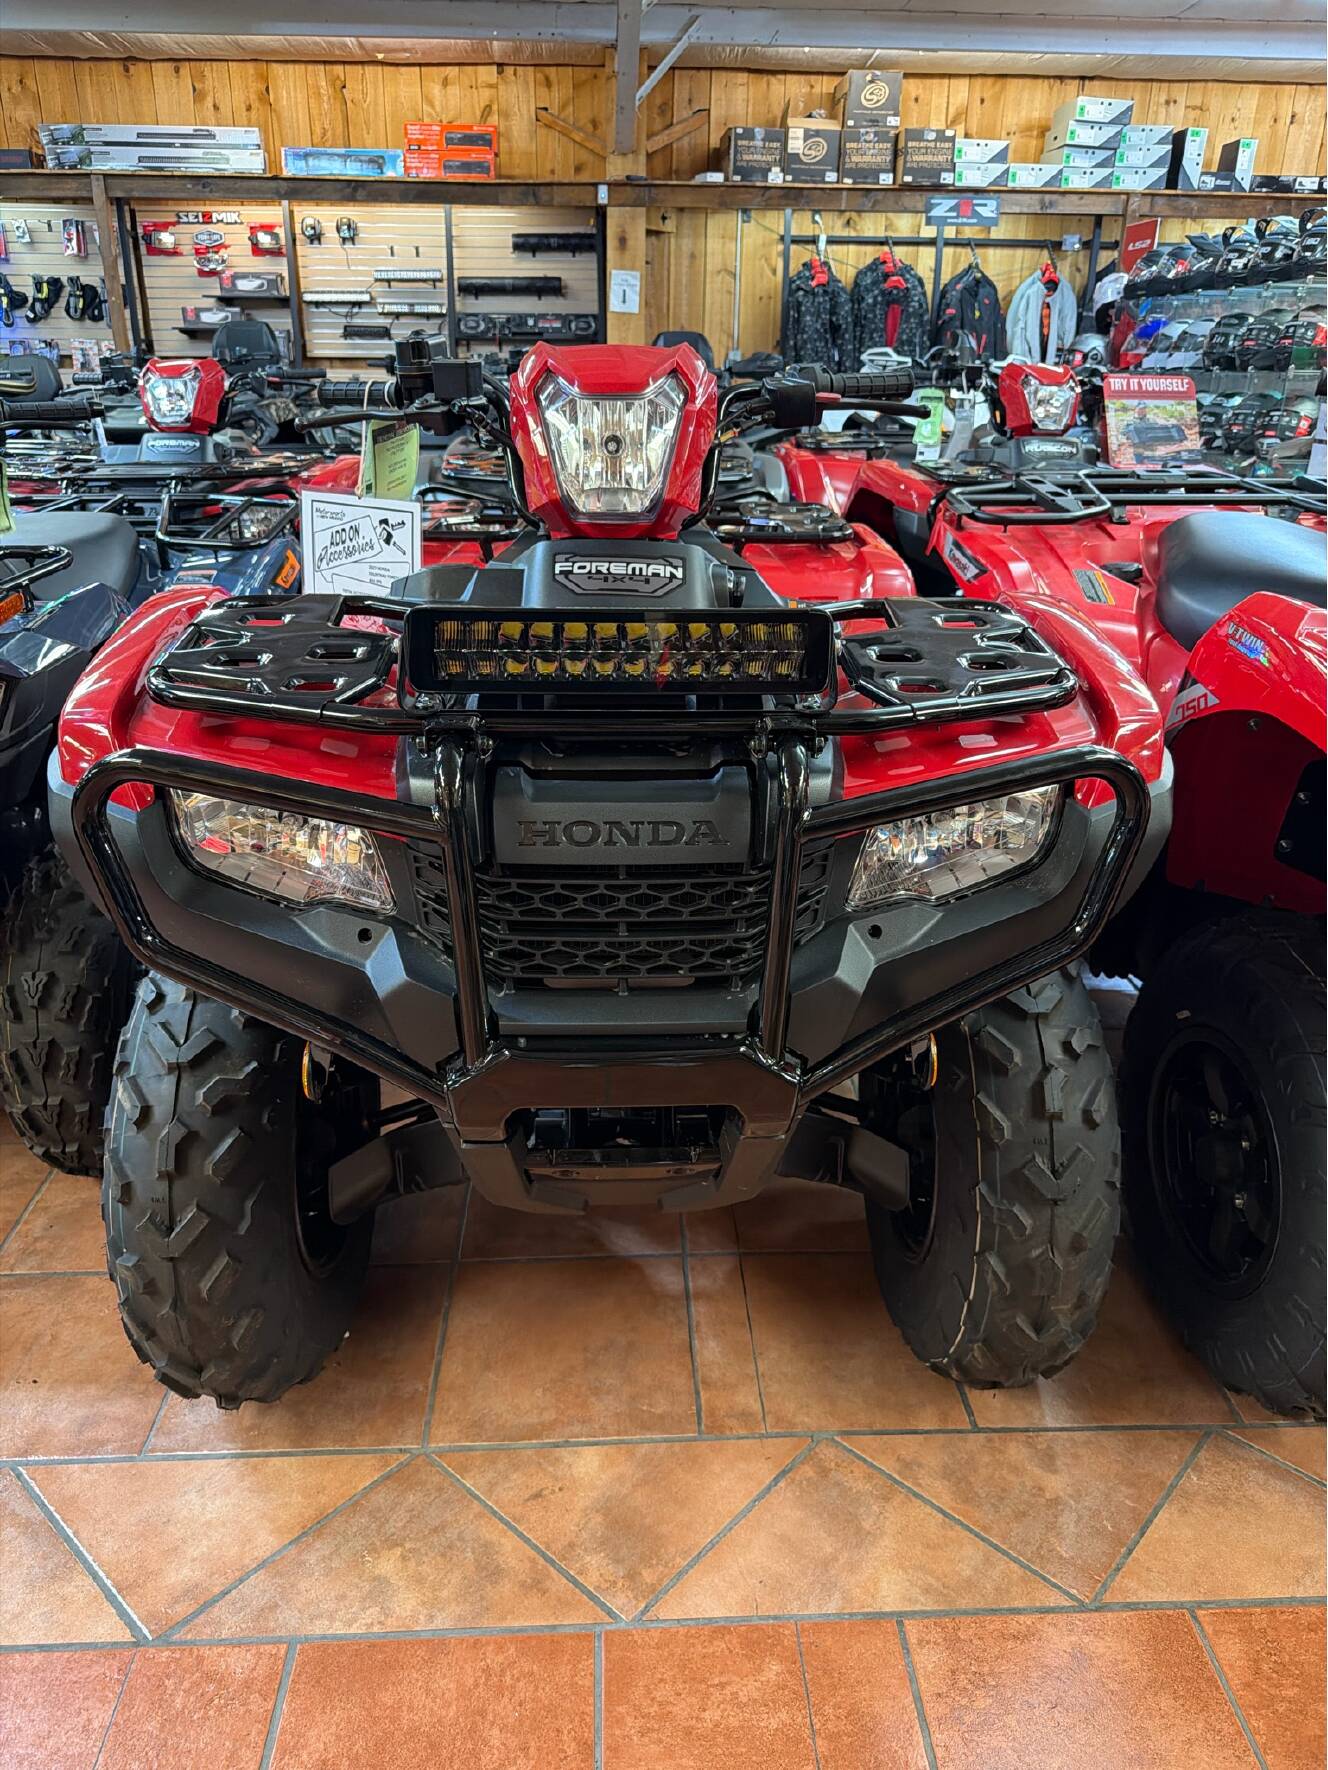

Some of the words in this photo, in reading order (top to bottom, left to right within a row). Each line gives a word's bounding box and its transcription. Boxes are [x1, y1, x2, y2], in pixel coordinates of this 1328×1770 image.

[177, 211, 242, 223] SEIZMIK
[1109, 378, 1127, 391] TRY
[1129, 379, 1139, 391] IT
[1140, 378, 1190, 391] YOURSELF
[330, 528, 347, 549] ADD
[348, 523, 360, 542] ON
[317, 536, 375, 569] Accessories
[554, 562, 683, 578] FOREMAN
[1175, 692, 1209, 720] 750
[517, 820, 730, 847] HONDA
